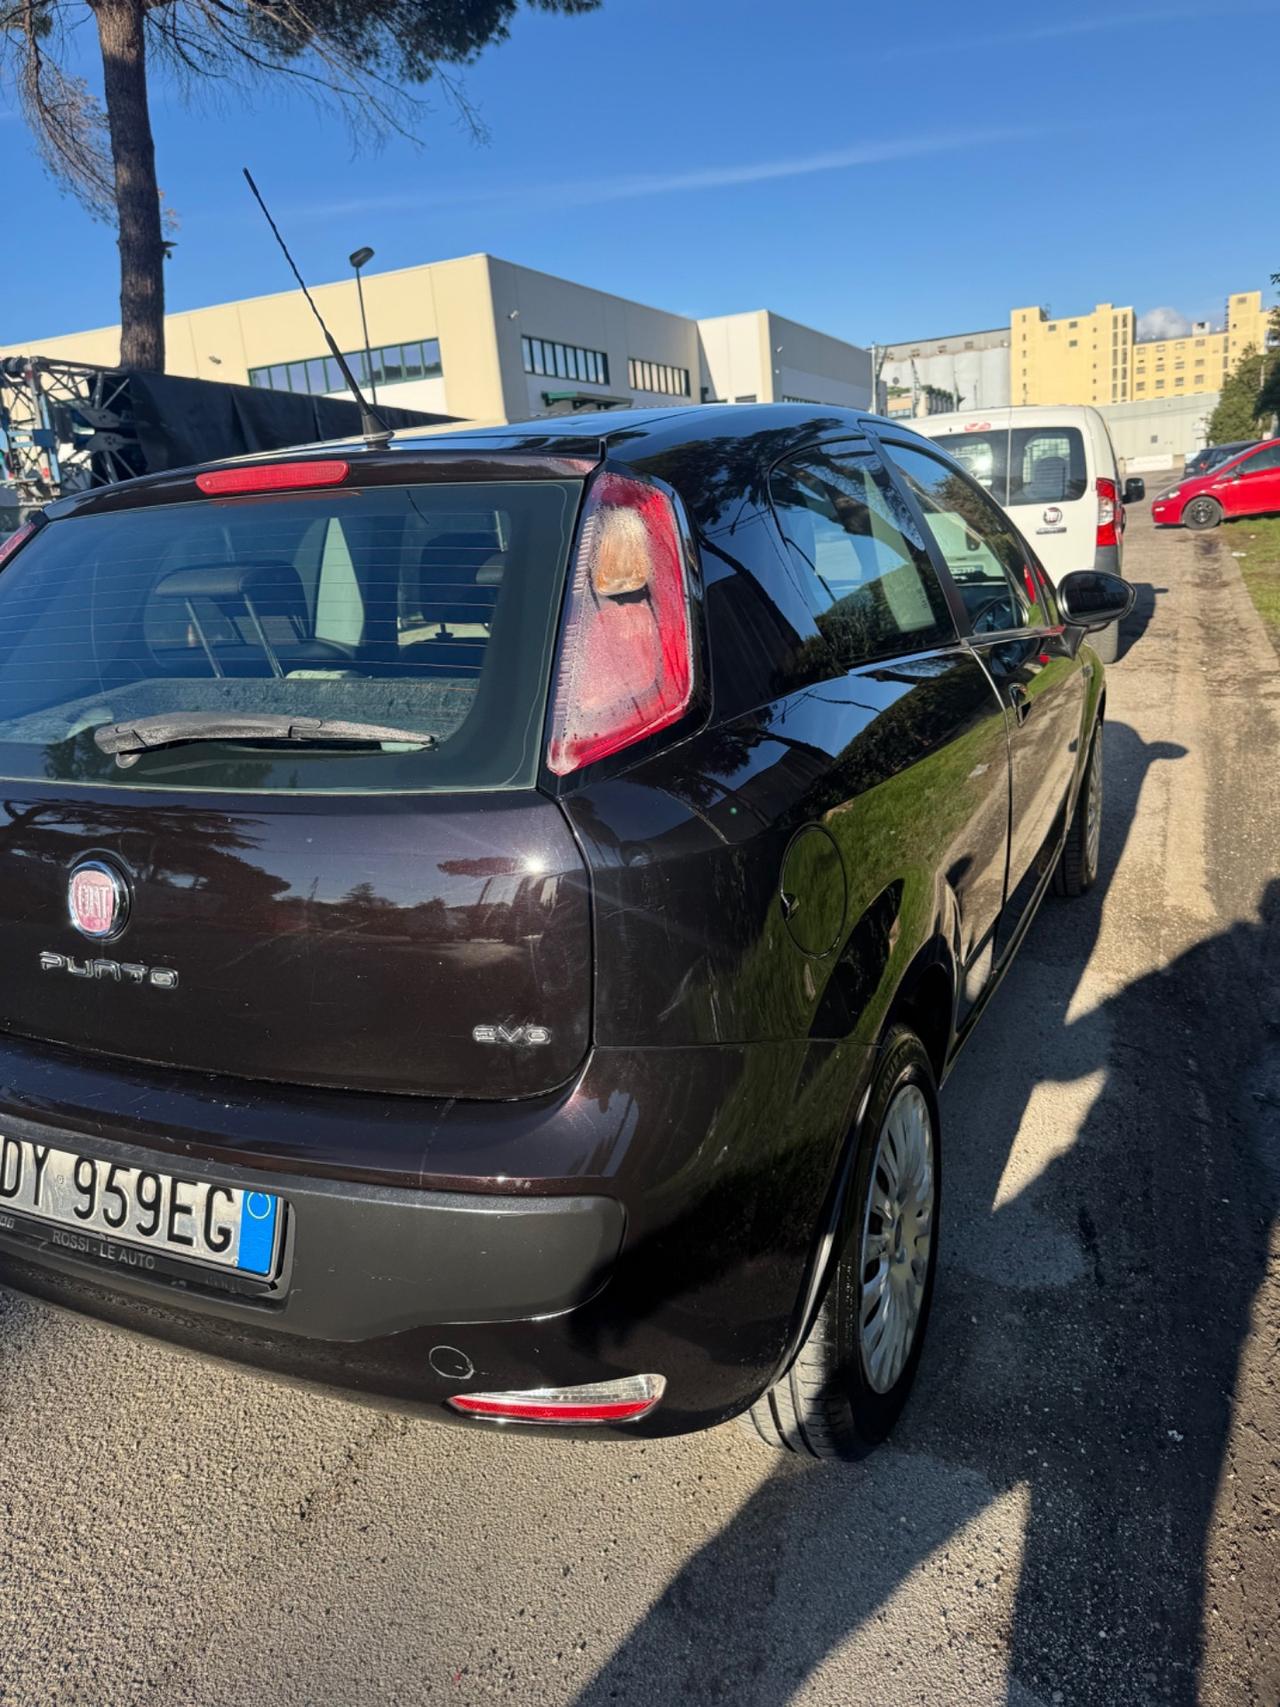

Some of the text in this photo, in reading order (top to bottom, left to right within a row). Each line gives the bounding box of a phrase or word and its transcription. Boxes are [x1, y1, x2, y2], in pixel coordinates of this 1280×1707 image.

[39, 951, 179, 989] PUNTO
[472, 1024, 552, 1045] EVO
[0, 1136, 235, 1253] DY 959EG
[52, 1230, 90, 1253] ROSSI
[99, 1241, 117, 1260] LE
[118, 1247, 156, 1270] AUTO
